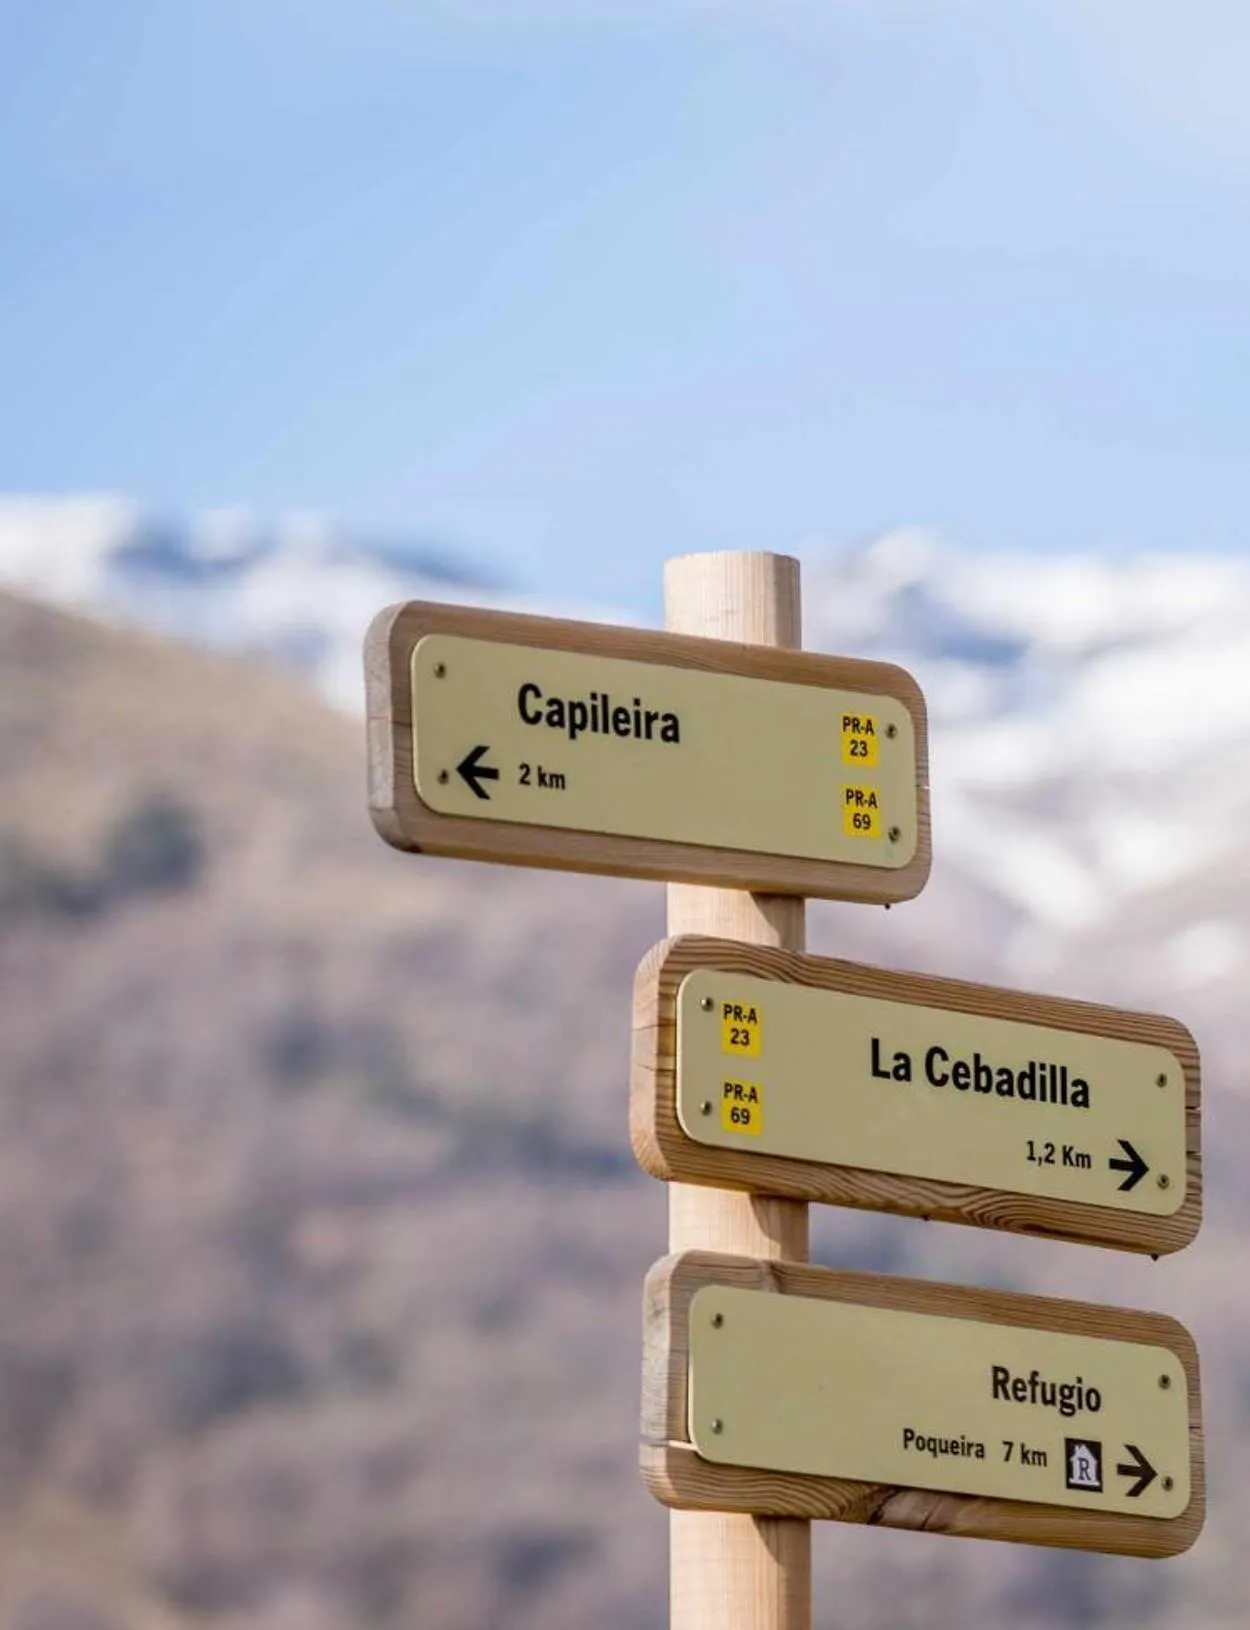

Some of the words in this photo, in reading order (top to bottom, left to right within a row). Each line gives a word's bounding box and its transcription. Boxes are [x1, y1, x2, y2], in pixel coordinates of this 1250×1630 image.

[517, 682, 680, 744] Capileira
[842, 715, 875, 736] PR-A
[849, 739, 869, 758] 23
[519, 762, 531, 786] 2
[537, 765, 566, 790] km
[845, 788, 878, 809] PR-A
[852, 812, 872, 831] 69
[723, 1003, 758, 1025] PR-A
[730, 1027, 750, 1047] 23
[871, 1037, 912, 1083] La
[924, 1045, 1090, 1109] Cebadilla
[723, 1081, 758, 1104] PR-A
[730, 1106, 751, 1125] 69
[1026, 1140, 1056, 1167] 1,2
[1062, 1145, 1092, 1170] Km
[991, 1365, 1102, 1418] Refugio
[903, 1427, 985, 1460] Poqueira
[1002, 1440, 1014, 1463] 7
[1020, 1442, 1048, 1468] km
[1078, 1457, 1091, 1481] R
